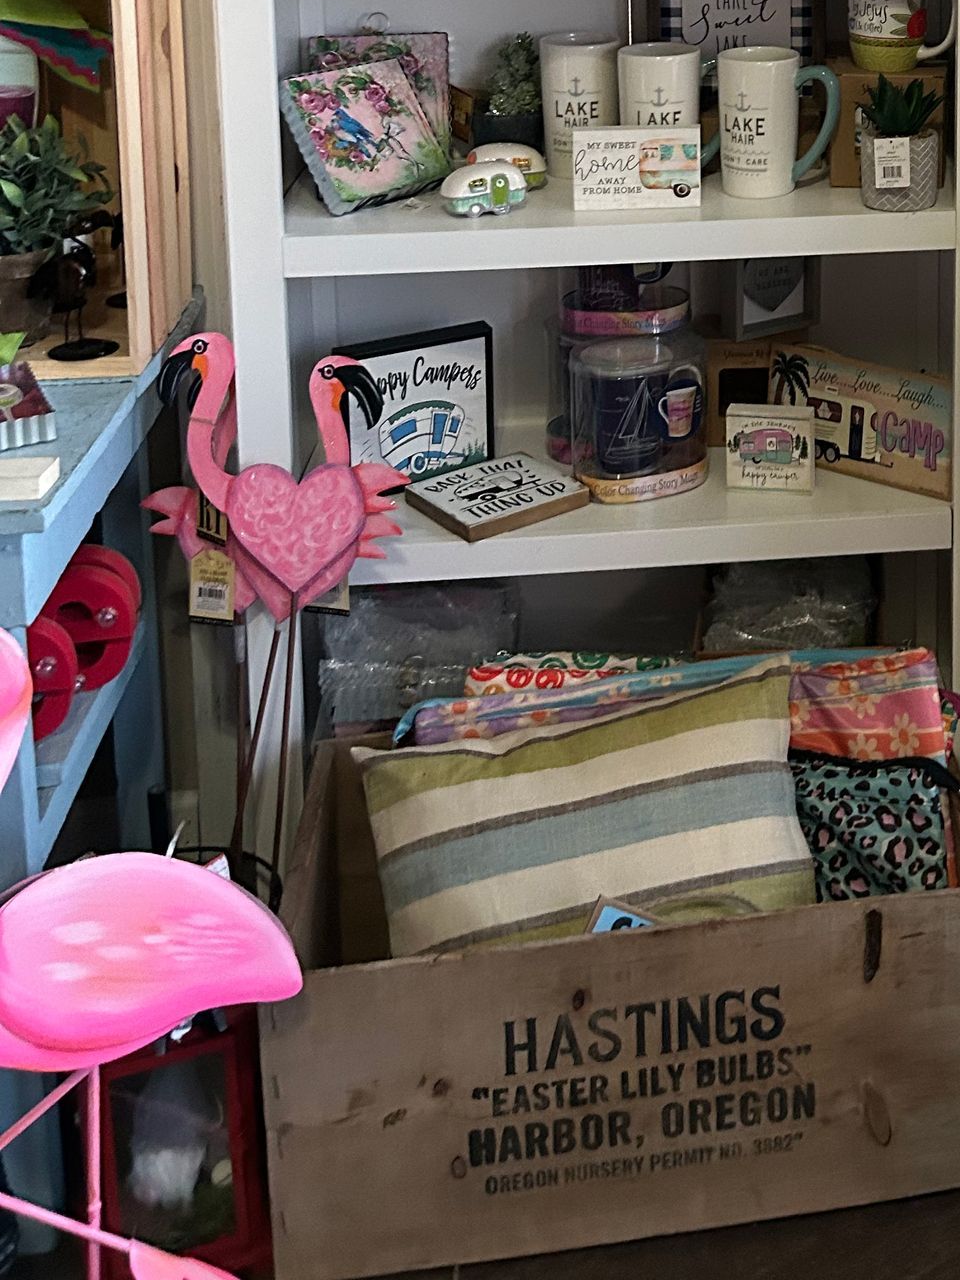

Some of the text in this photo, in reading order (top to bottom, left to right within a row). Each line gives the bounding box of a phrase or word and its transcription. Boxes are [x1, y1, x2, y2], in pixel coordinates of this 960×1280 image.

[554, 99, 600, 119] LAKE
[563, 116, 589, 128] HAIR
[724, 113, 766, 136] LAKE
[586, 141, 637, 151] MY SWEET
[731, 133, 756, 146] HAIR
[574, 149, 641, 182] home
[745, 158, 769, 166] CARE
[581, 186, 643, 195] FROM HOME
[598, 177, 626, 186] AWAY
[376, 355, 482, 401] ppy Campers
[425, 459, 524, 494] BACK THAT
[617, 482, 657, 497] Changing
[658, 478, 679, 491] Story
[466, 481, 566, 518] THING UP
[503, 984, 786, 1077] HASTINGS
[620, 1062, 686, 1101] LILY
[467, 1082, 817, 1168] HARBOR, OREGON
[484, 1164, 560, 1195] OREGON
[563, 1155, 645, 1184] NURSERY
[649, 1146, 715, 1172] PERMIT
